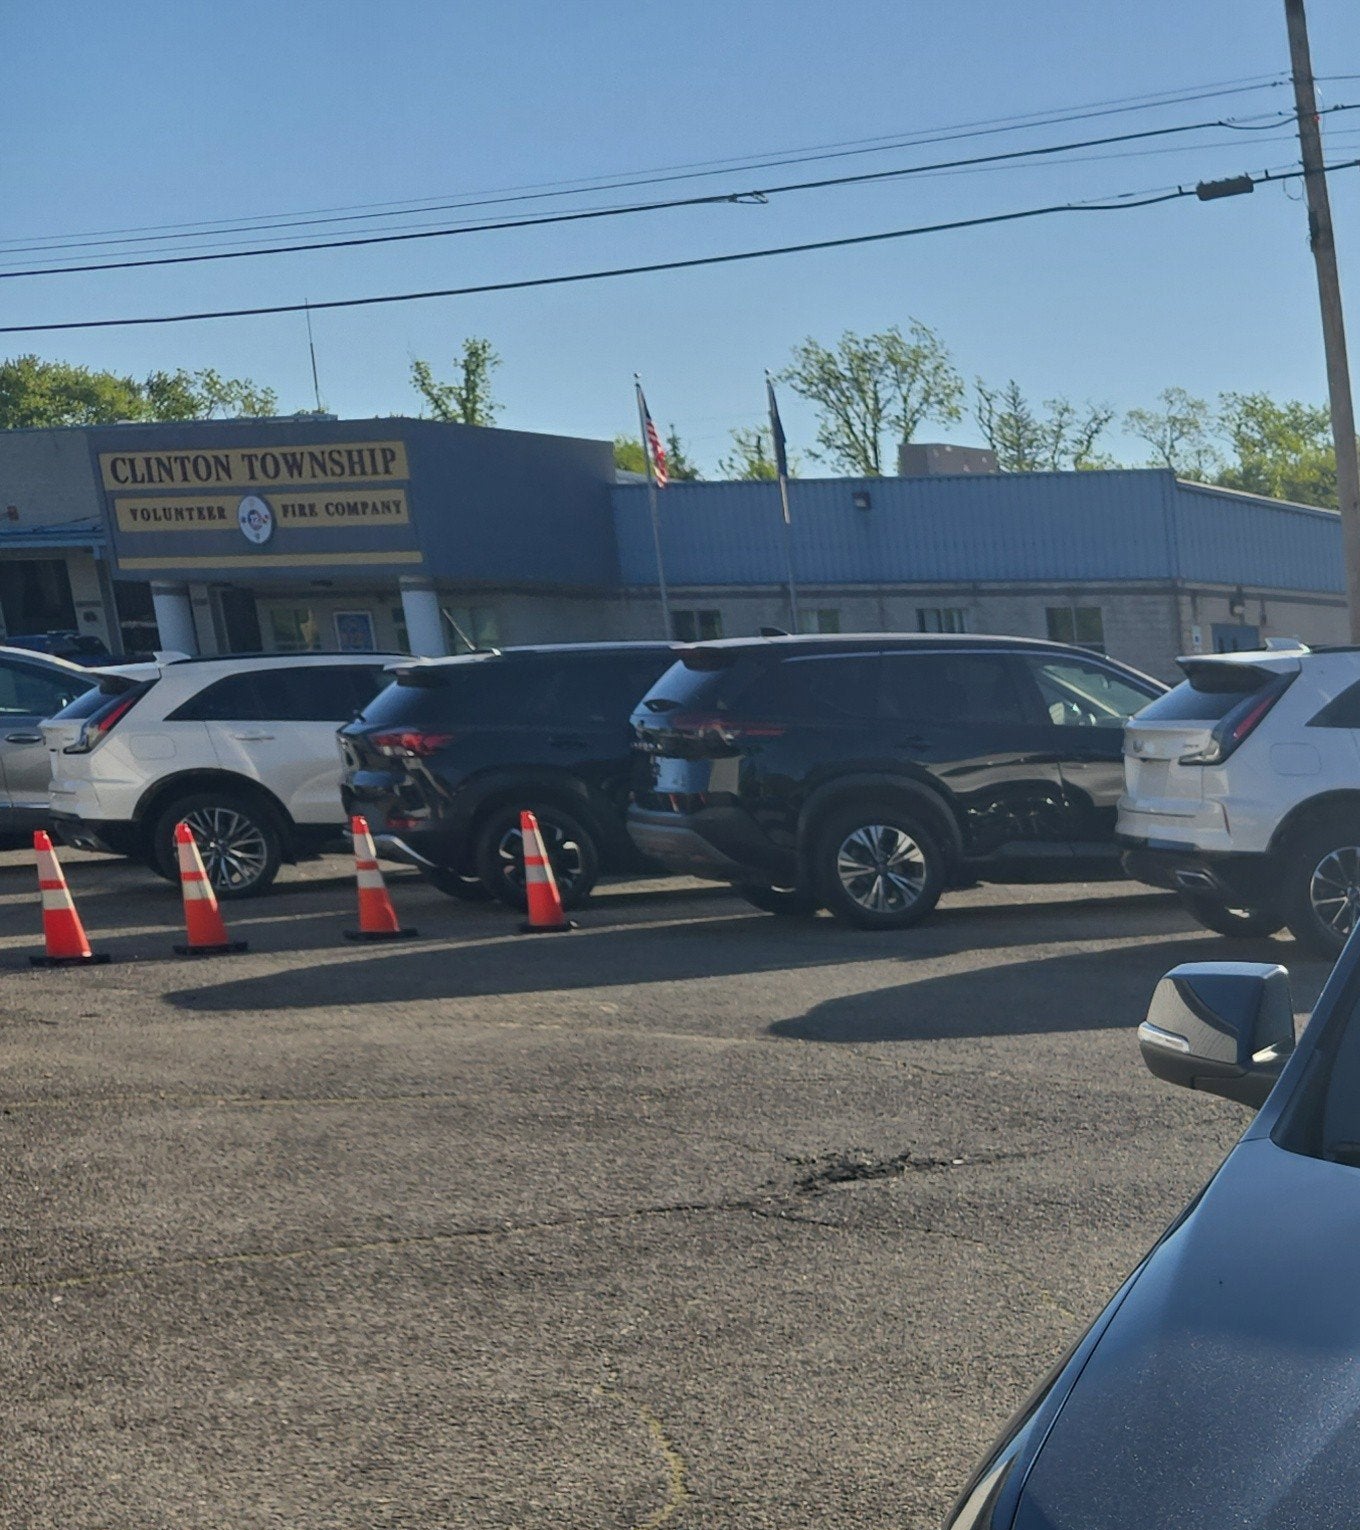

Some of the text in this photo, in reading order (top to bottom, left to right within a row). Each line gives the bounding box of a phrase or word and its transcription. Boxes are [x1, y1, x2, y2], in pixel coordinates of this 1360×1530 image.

[110, 447, 397, 485] CLINTON TOWNSHIP
[129, 506, 228, 523] VOLUNTEER
[281, 502, 319, 519] FIRE
[324, 500, 402, 518] COMPANY
